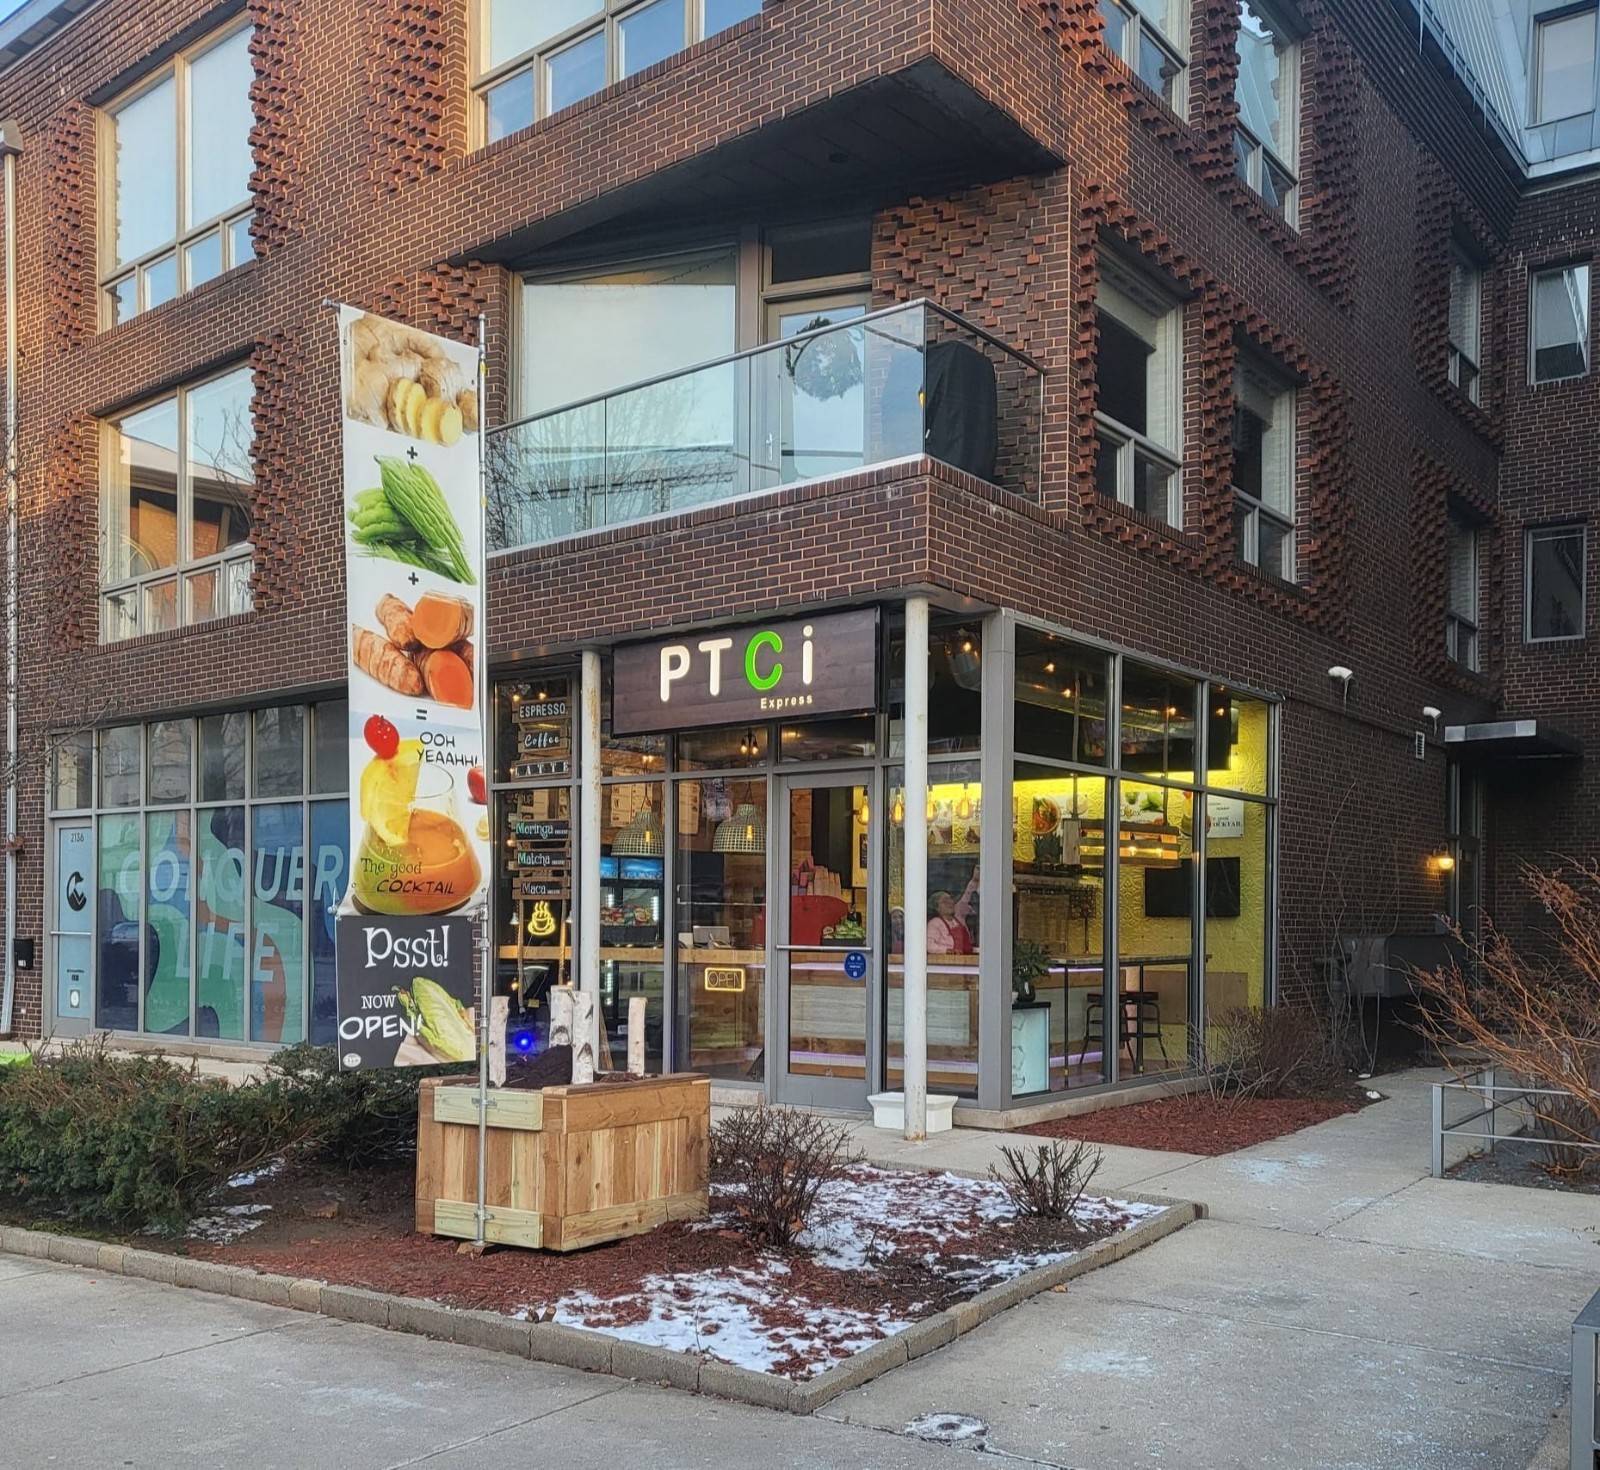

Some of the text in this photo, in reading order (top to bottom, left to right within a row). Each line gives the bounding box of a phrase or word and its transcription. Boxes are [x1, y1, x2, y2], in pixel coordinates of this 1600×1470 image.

[760, 694, 813, 709] Express
[520, 703, 566, 717] ESPRESSO
[420, 732, 455, 748] OOH
[524, 732, 560, 747] Coffee
[417, 749, 478, 768] YEAAHH!
[515, 761, 569, 776] LATTE
[516, 821, 553, 839] Moringa
[517, 852, 550, 866] Matcha
[361, 858, 422, 879] The good
[377, 879, 455, 895] COCKTAIL
[522, 882, 546, 895] Maca
[175, 921, 279, 982] LIFE
[362, 925, 450, 968] Psst!
[708, 971, 741, 988] OPEN
[361, 995, 396, 1009] NOW
[339, 1014, 422, 1040] OPEN!
